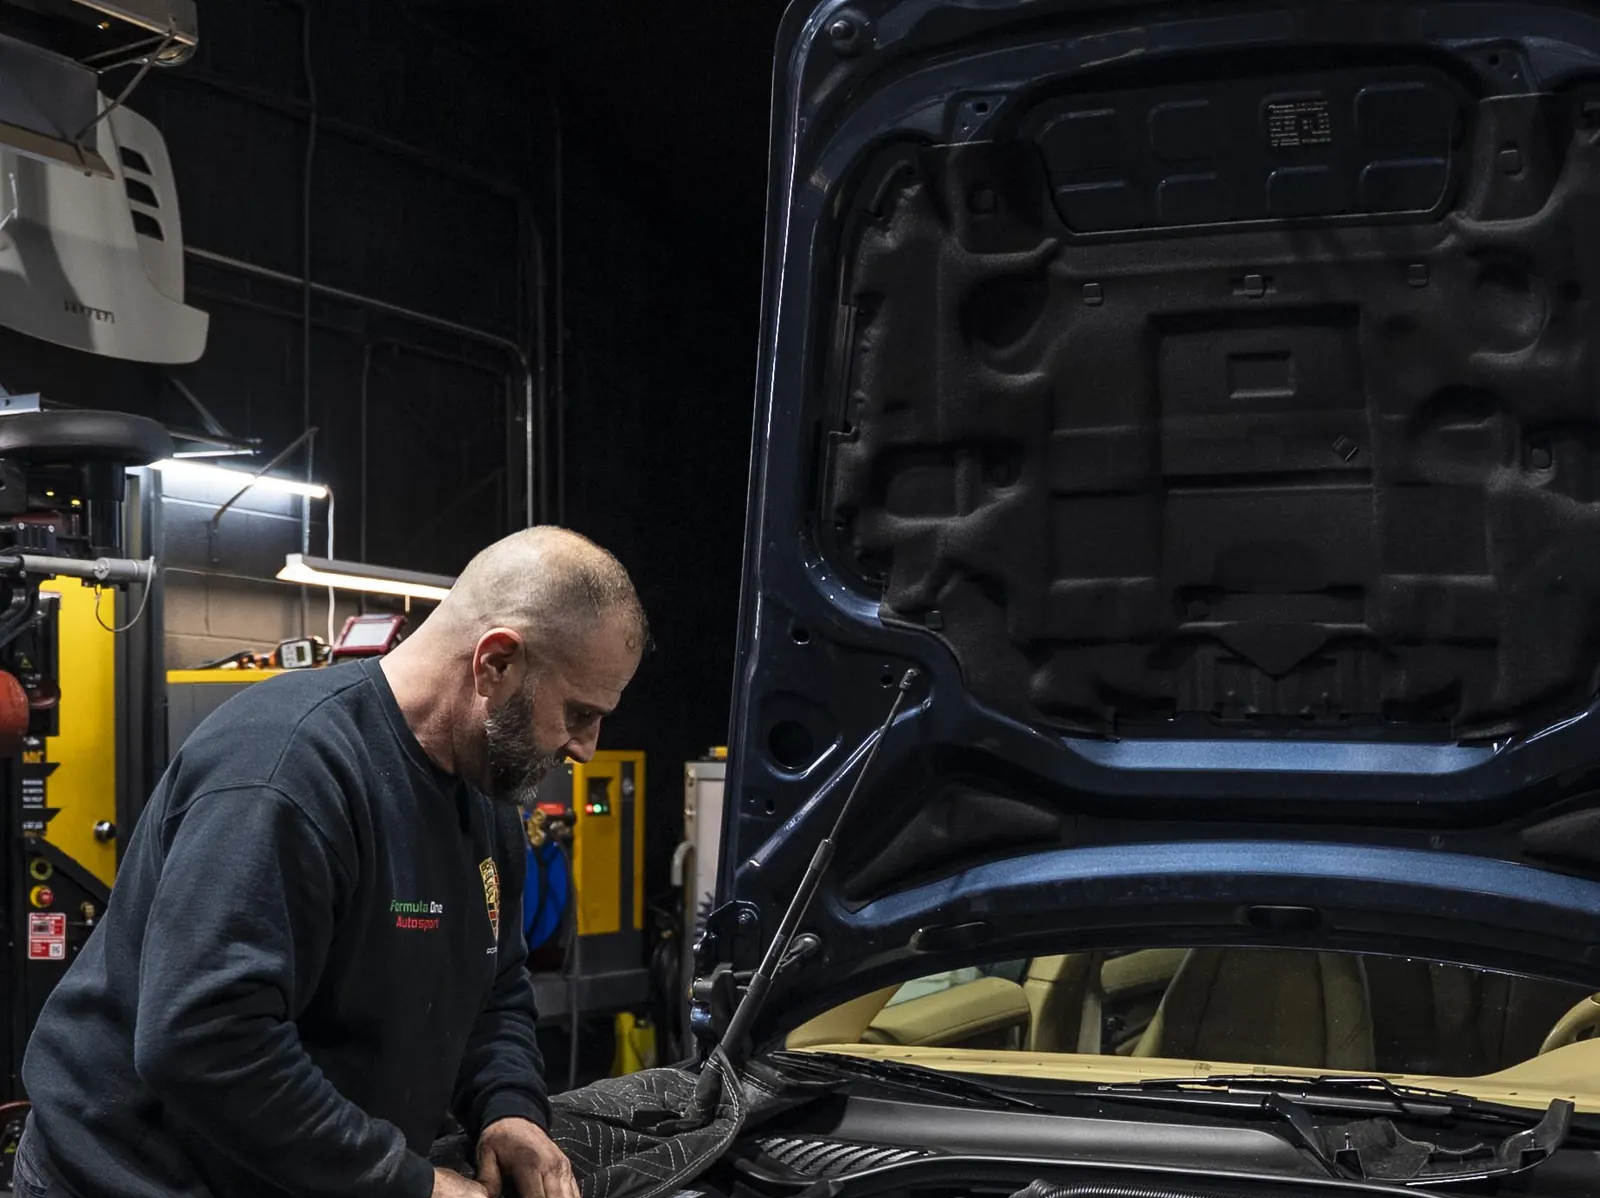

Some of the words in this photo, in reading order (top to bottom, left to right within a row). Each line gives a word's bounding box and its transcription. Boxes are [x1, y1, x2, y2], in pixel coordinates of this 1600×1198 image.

[390, 900, 429, 913] Formula
[430, 901, 443, 913] One
[396, 916, 440, 932] Autosport
